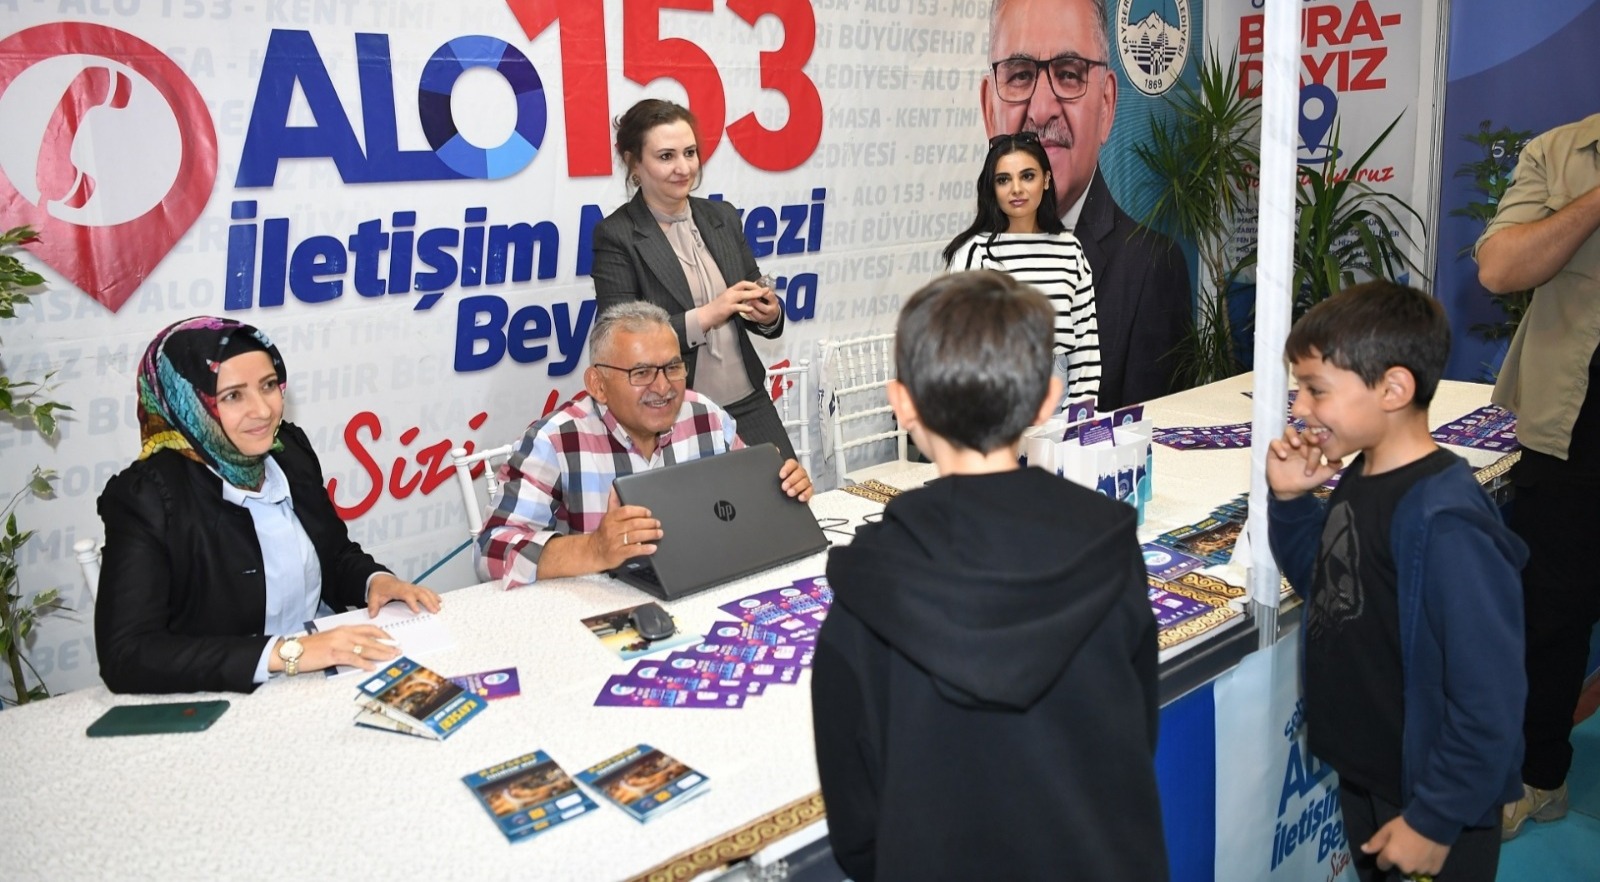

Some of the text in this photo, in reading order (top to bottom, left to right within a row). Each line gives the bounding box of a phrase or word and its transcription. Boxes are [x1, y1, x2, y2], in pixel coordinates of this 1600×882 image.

[1240, 0, 1402, 55] BRA-
[921, 66, 960, 91] ALO
[1145, 78, 1163, 90] 1869
[1238, 47, 1388, 100] DYIZ
[235, 0, 823, 188] ALO 153
[829, 107, 881, 128] MASA
[895, 107, 942, 128] KENT
[912, 144, 967, 165] BEYAZ
[852, 185, 887, 207] ALO
[893, 183, 925, 204] 153
[224, 200, 559, 311] İletişim
[714, 500, 736, 522] hp
